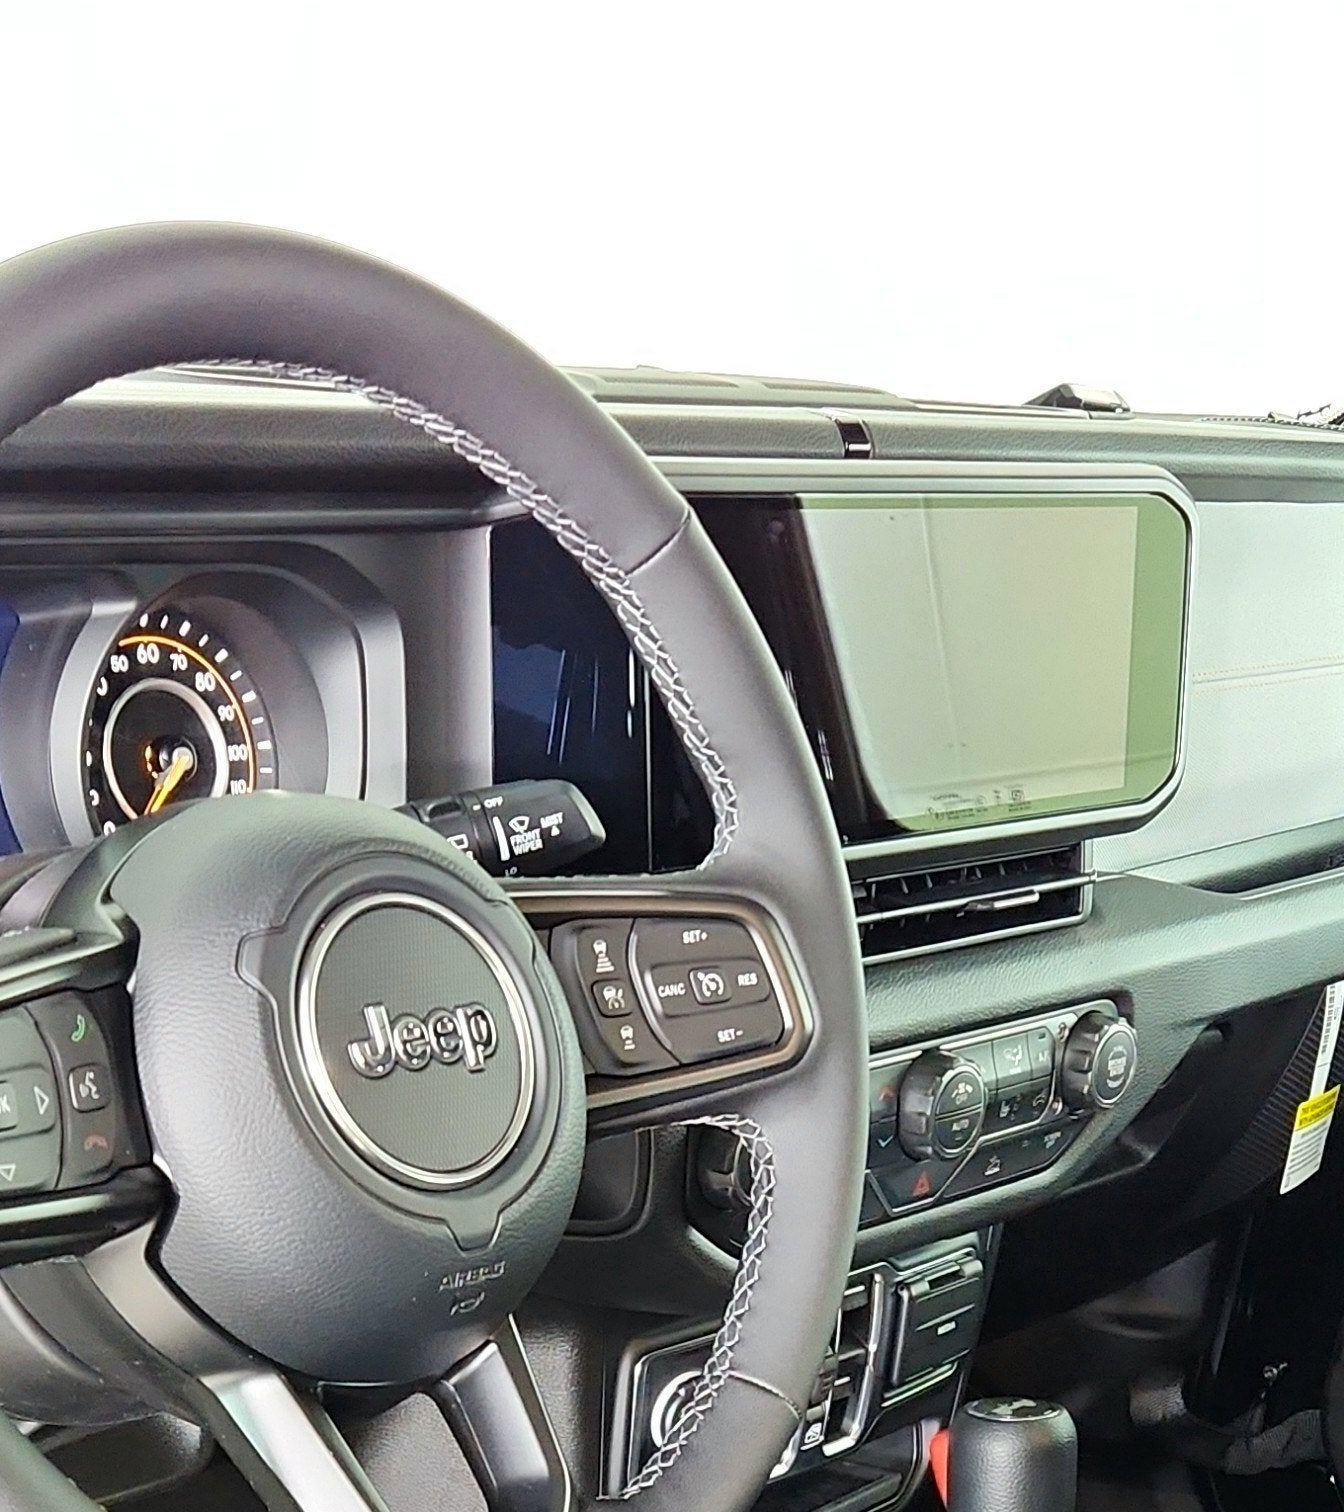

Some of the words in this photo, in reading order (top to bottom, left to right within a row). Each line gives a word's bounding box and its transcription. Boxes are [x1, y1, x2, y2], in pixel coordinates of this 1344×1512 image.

[137, 644, 159, 663] 60
[170, 653, 188, 671] 70
[110, 655, 129, 672] 50
[195, 672, 216, 691] 80
[217, 705, 234, 721] 90
[228, 746, 248, 761] 100
[230, 780, 247, 795] 110
[509, 828, 542, 847] FRONT
[512, 839, 544, 856] WIPER
[737, 972, 758, 987] RES
[657, 982, 686, 998] CANC
[346, 1001, 498, 1080] Jeep
